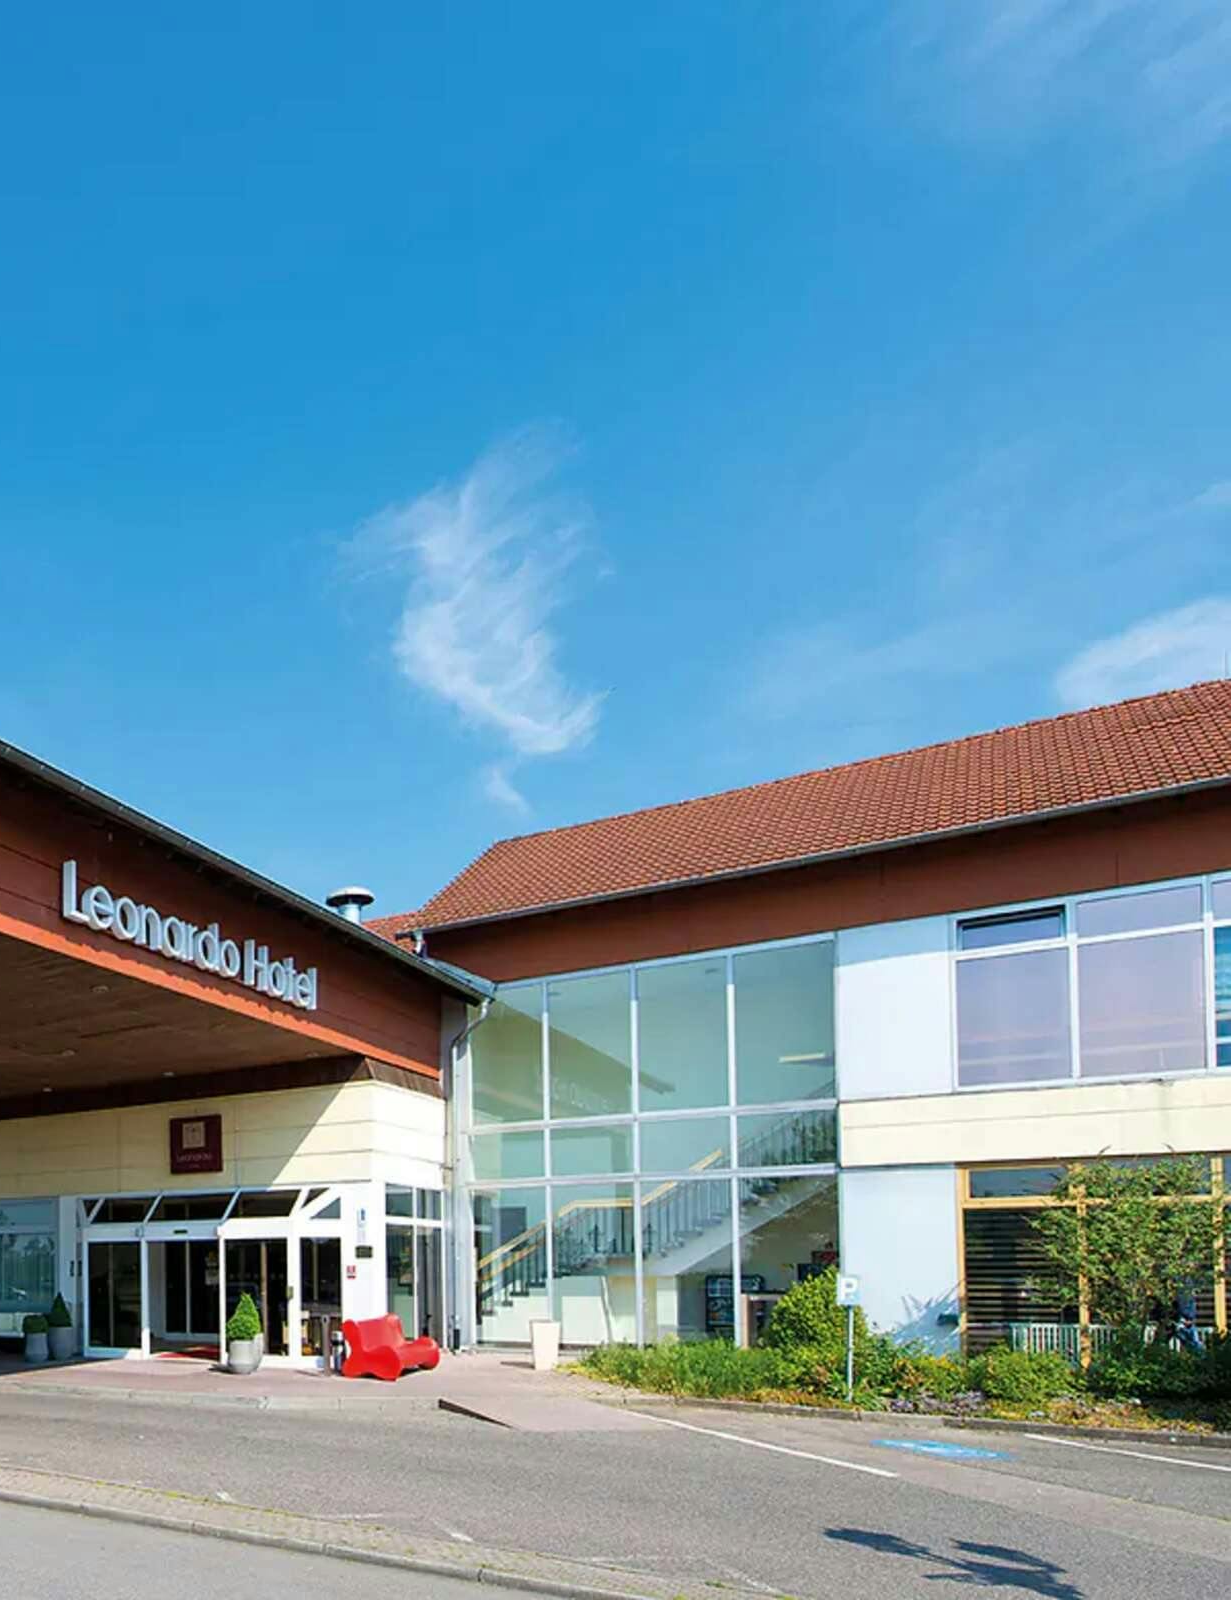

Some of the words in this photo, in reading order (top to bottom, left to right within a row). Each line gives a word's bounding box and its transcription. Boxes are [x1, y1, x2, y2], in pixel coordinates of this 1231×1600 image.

[63, 860, 241, 977] Leonardo
[243, 939, 317, 1010] Hotel
[840, 1278, 858, 1300] P
